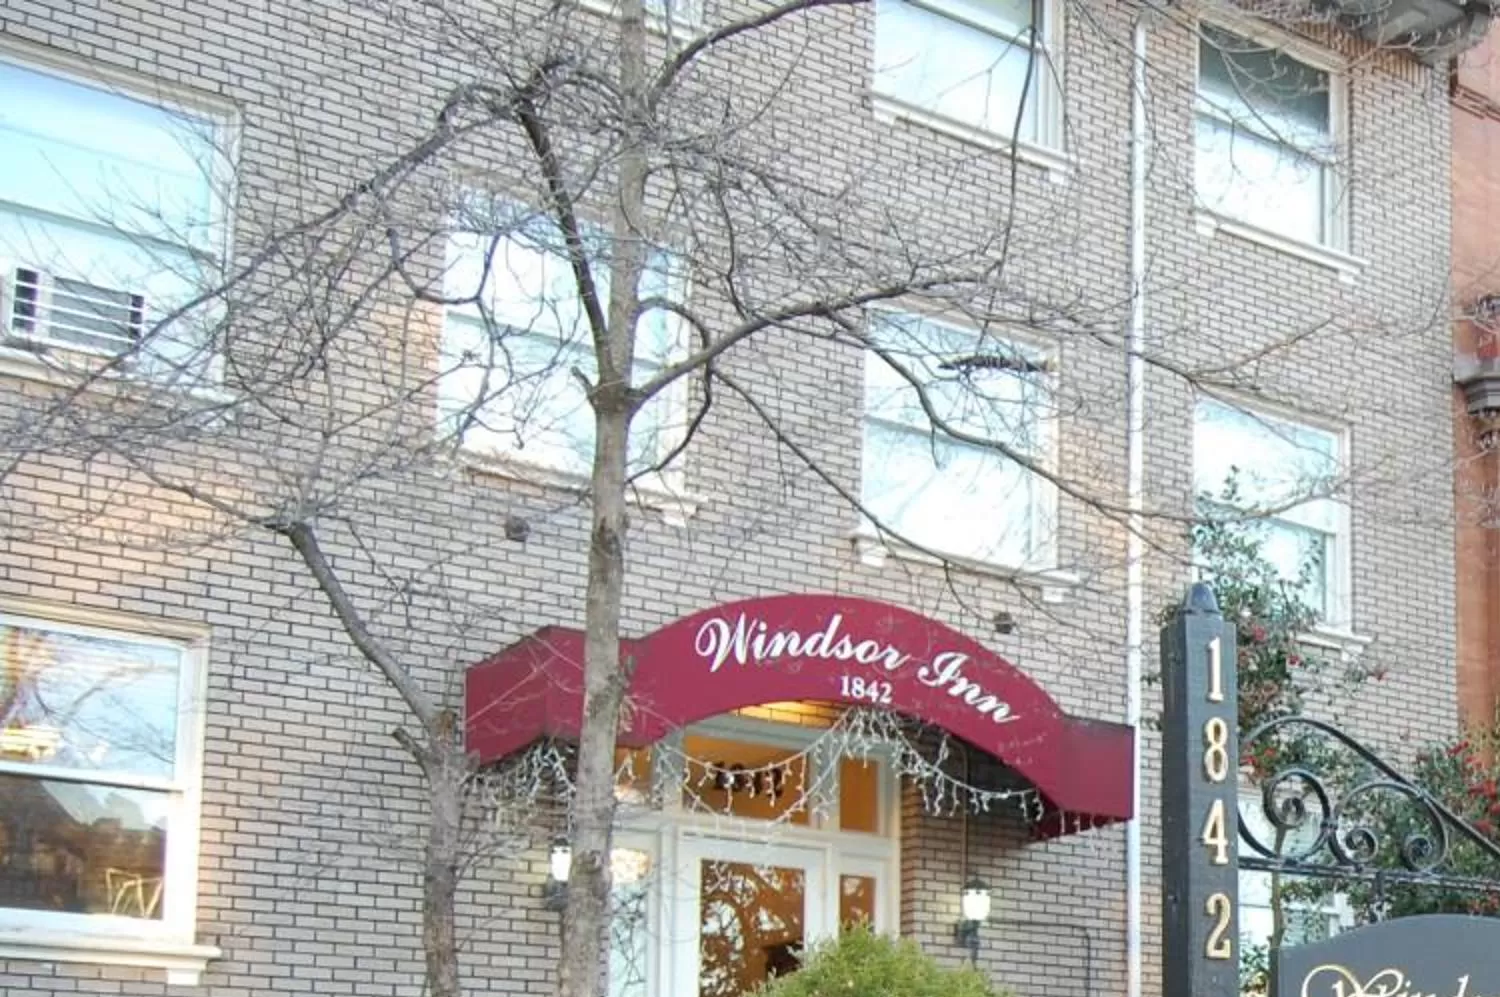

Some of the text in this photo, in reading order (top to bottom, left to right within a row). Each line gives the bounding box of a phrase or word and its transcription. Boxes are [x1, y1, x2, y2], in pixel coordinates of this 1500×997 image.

[695, 612, 1020, 724] Windsor Inn
[840, 675, 893, 705] 1842
[1203, 636, 1231, 959] 1842
